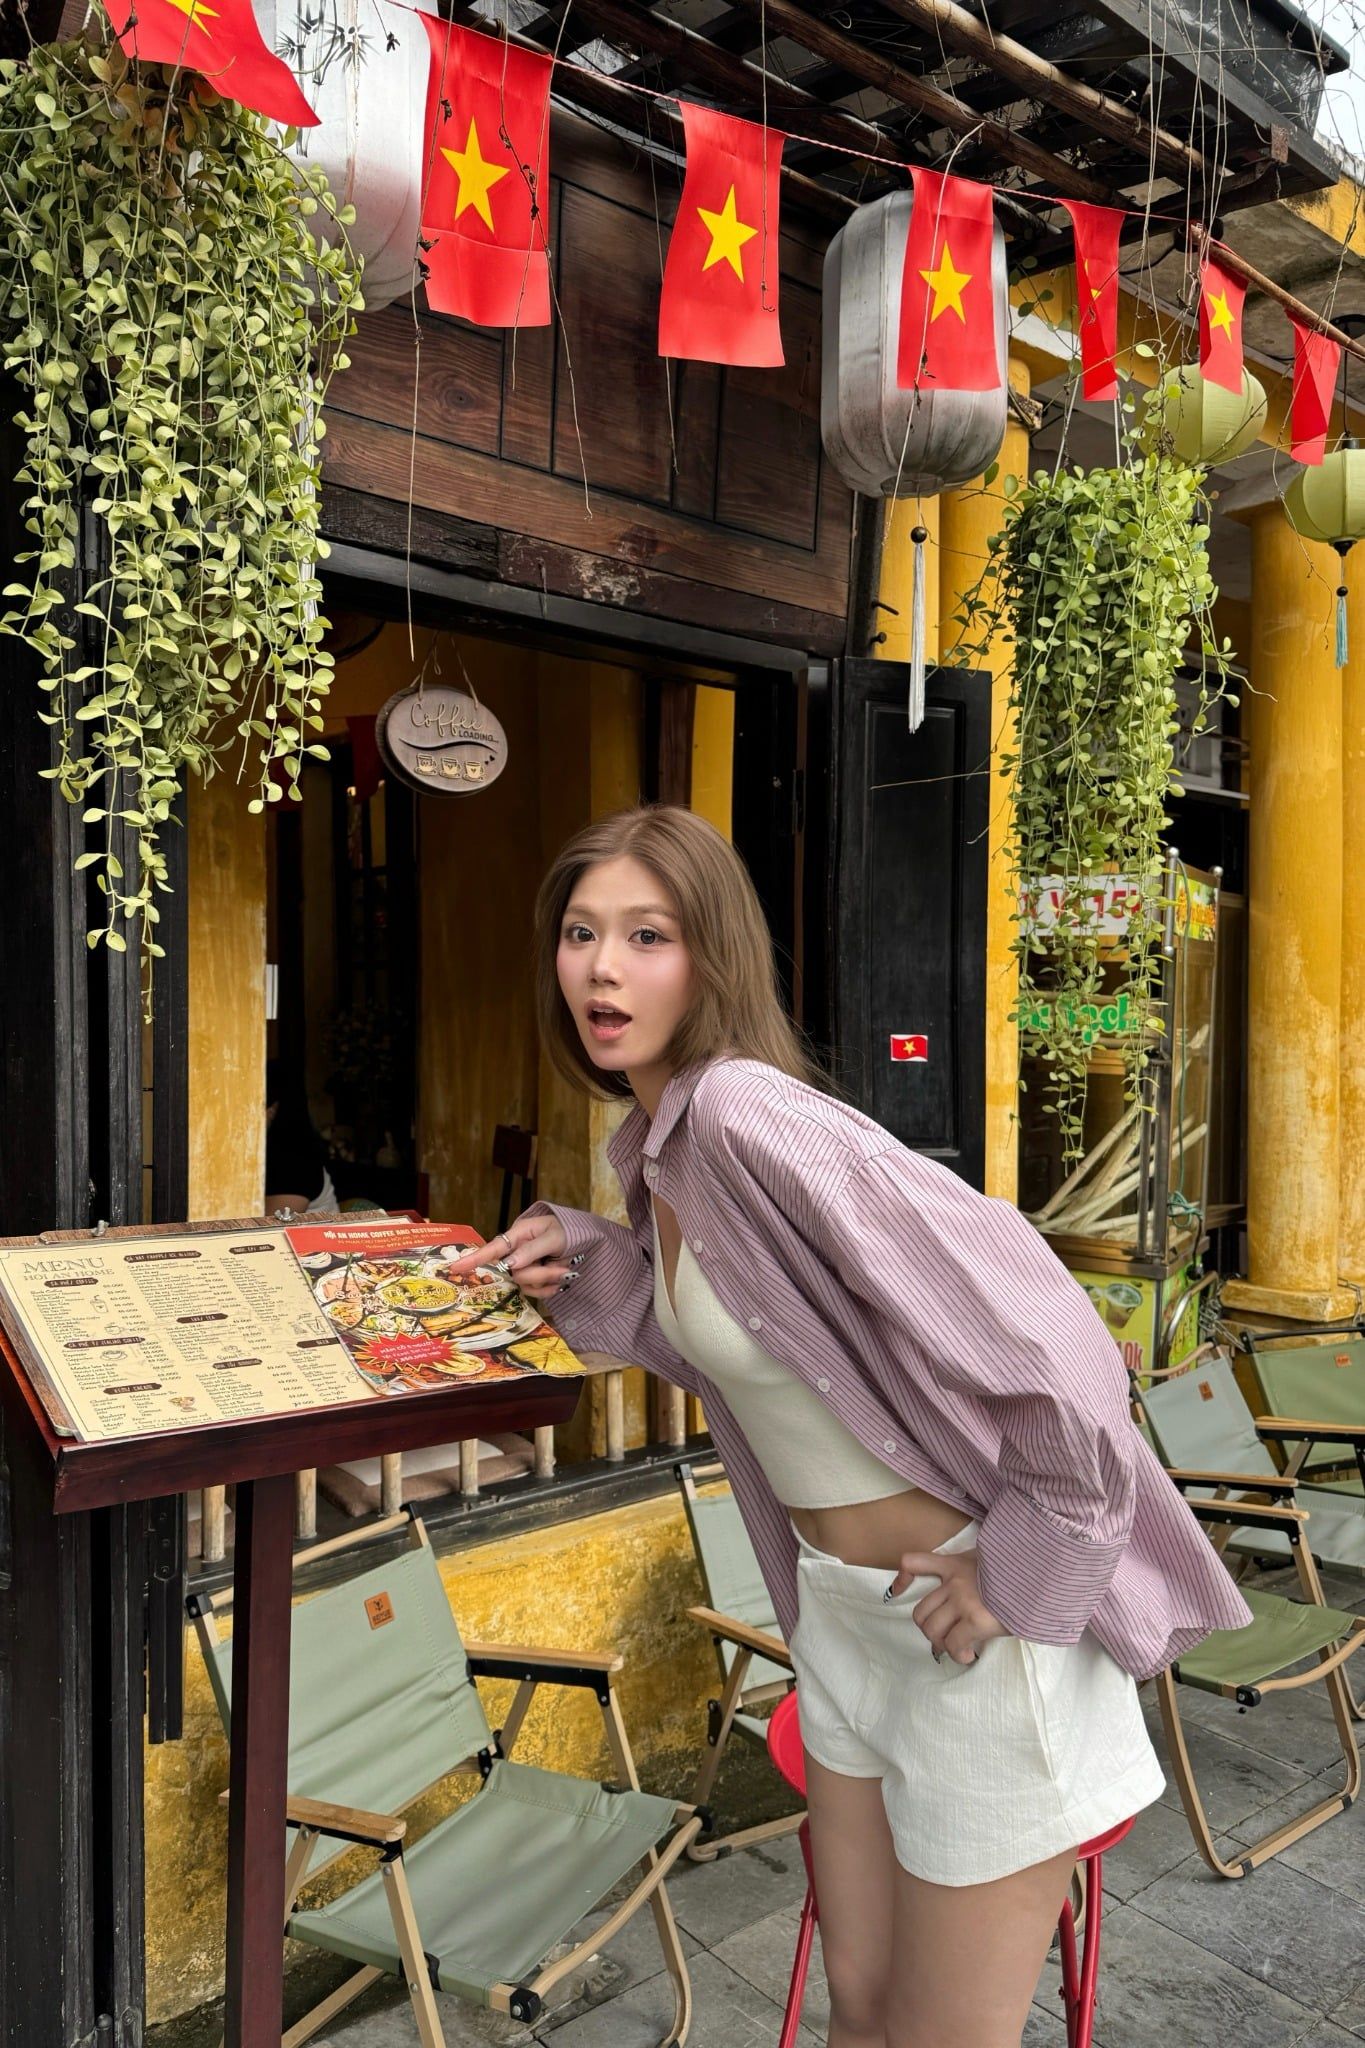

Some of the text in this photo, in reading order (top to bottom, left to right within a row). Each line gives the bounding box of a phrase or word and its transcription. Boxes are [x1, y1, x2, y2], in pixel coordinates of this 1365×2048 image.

[411, 703, 481, 737] Coffee
[348, 1231, 370, 1239] HOME
[371, 1230, 394, 1238] COFFEE
[23, 1257, 105, 1274] MENU
[53, 1272, 71, 1280] AN
[75, 1269, 115, 1278] HOME
